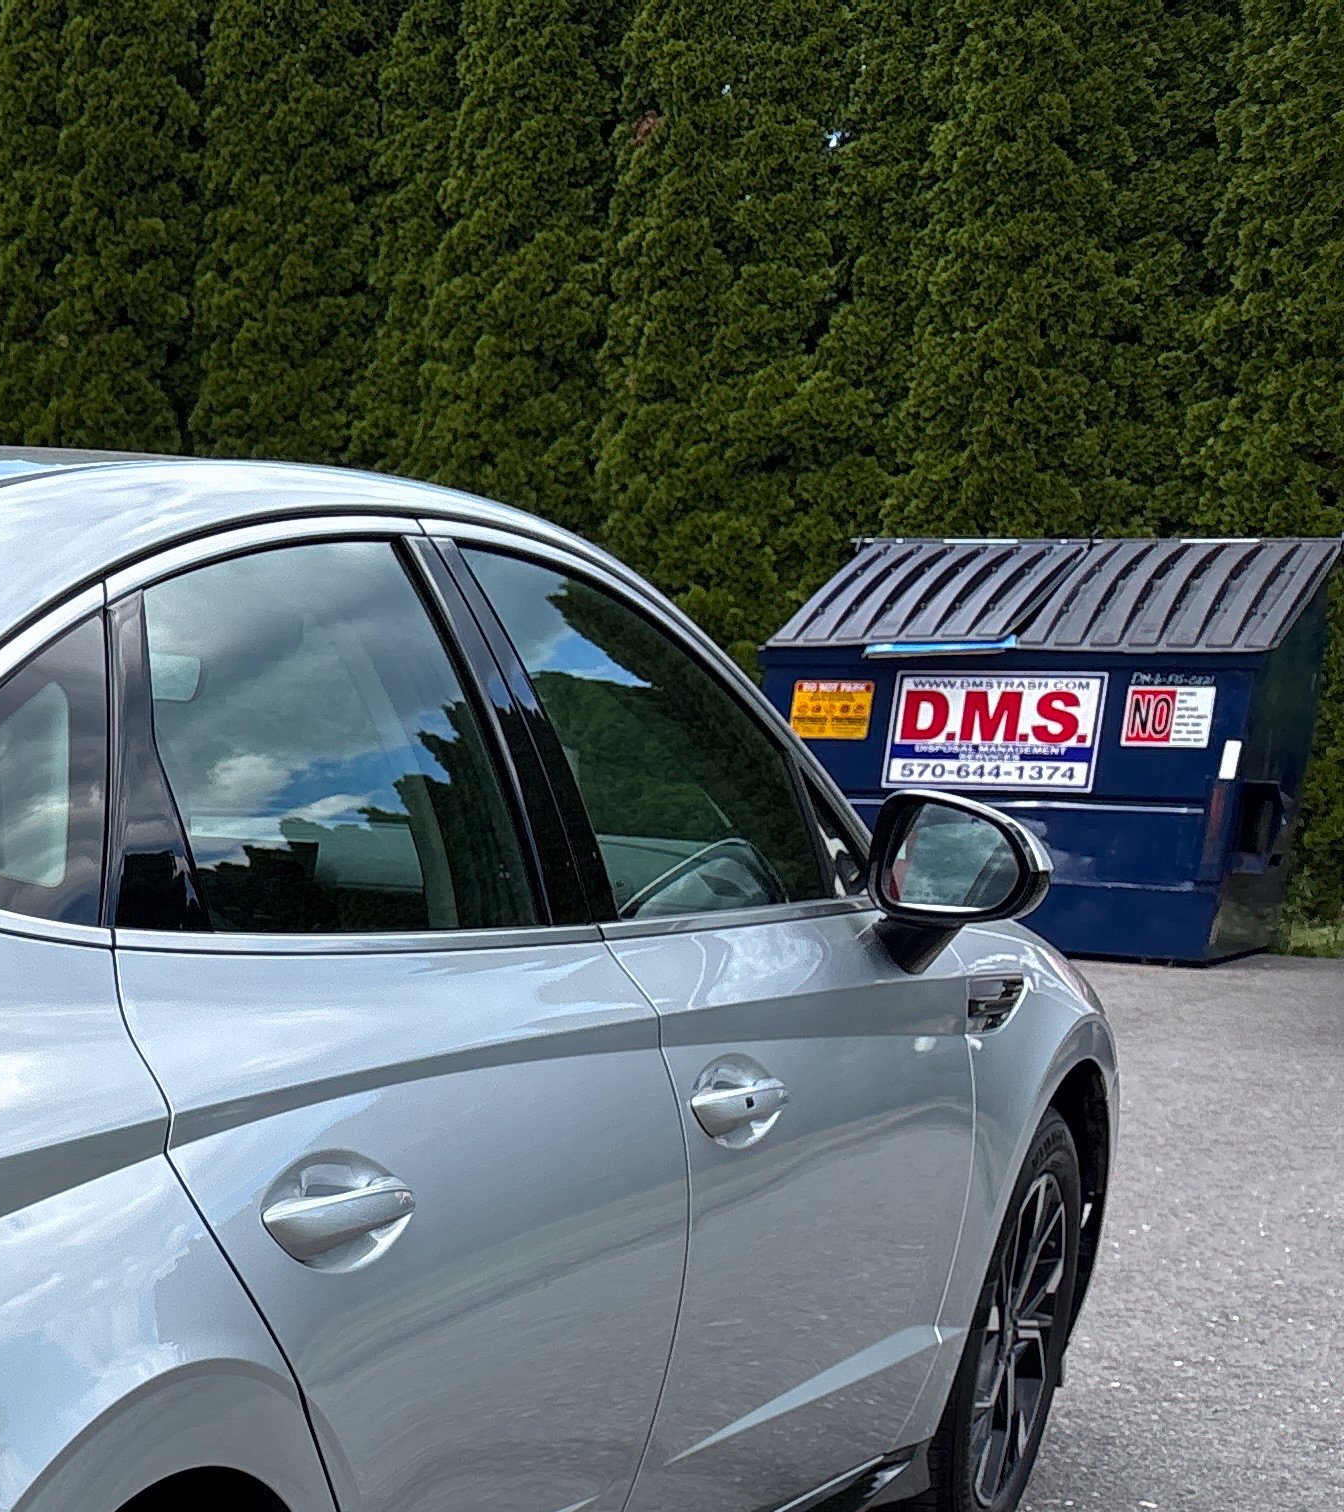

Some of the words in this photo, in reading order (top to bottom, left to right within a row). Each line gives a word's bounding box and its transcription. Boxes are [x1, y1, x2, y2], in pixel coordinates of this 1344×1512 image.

[913, 680, 1091, 690] WWW.DMSTRASH.COM
[901, 690, 1088, 743] D.M.S.
[1129, 696, 1172, 737] NO
[900, 763, 1076, 781] 570-644-1374
